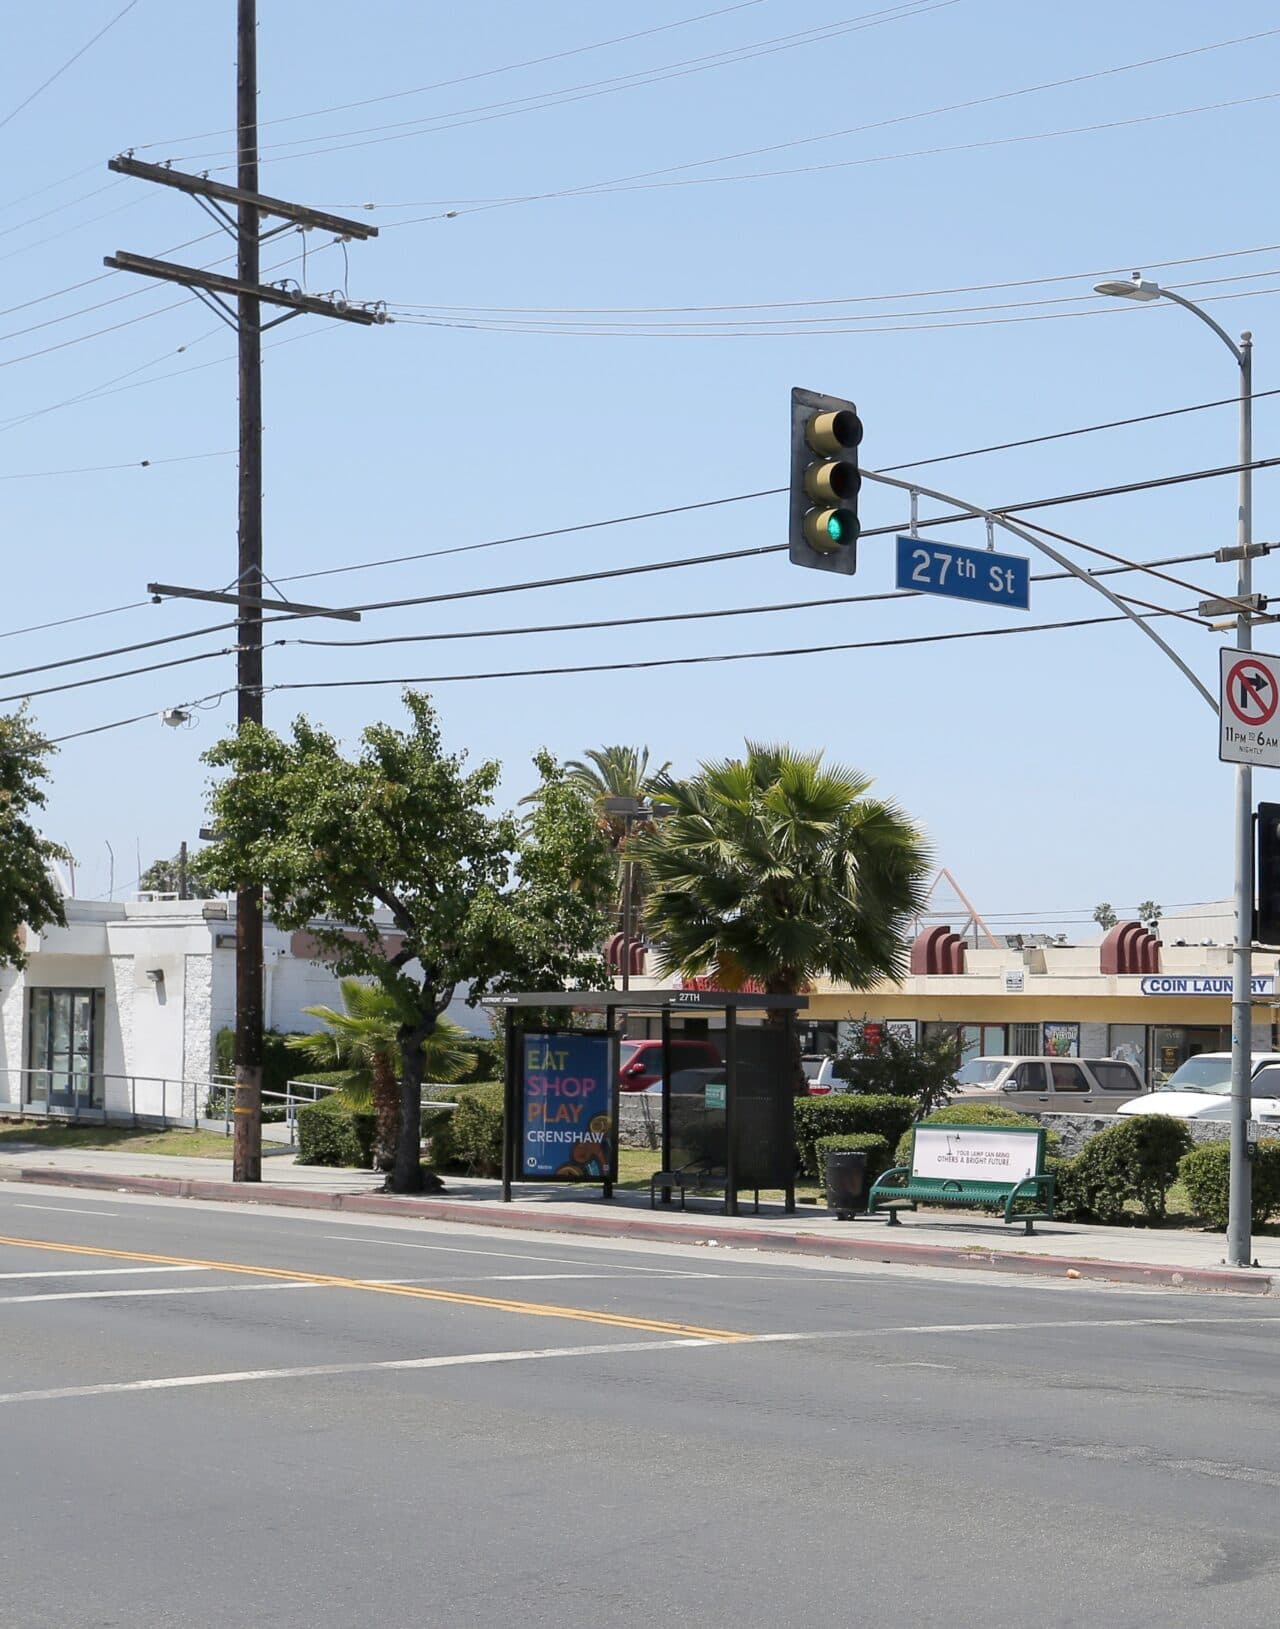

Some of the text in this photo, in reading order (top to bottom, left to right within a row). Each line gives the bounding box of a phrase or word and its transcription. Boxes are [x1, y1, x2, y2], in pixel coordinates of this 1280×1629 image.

[912, 549, 1015, 594] 27th St
[1239, 746, 1263, 754] NIGHTLY
[1150, 979, 1267, 993] COIN LAUNRY
[679, 993, 700, 1001] 27TH
[527, 1051, 569, 1071] EAT
[527, 1076, 596, 1097] SHOP
[528, 1103, 583, 1123] PLAY
[527, 1131, 604, 1143] CRENSHAW
[937, 1155, 959, 1163] OTHERS
[966, 1157, 987, 1165] BRIGHT
